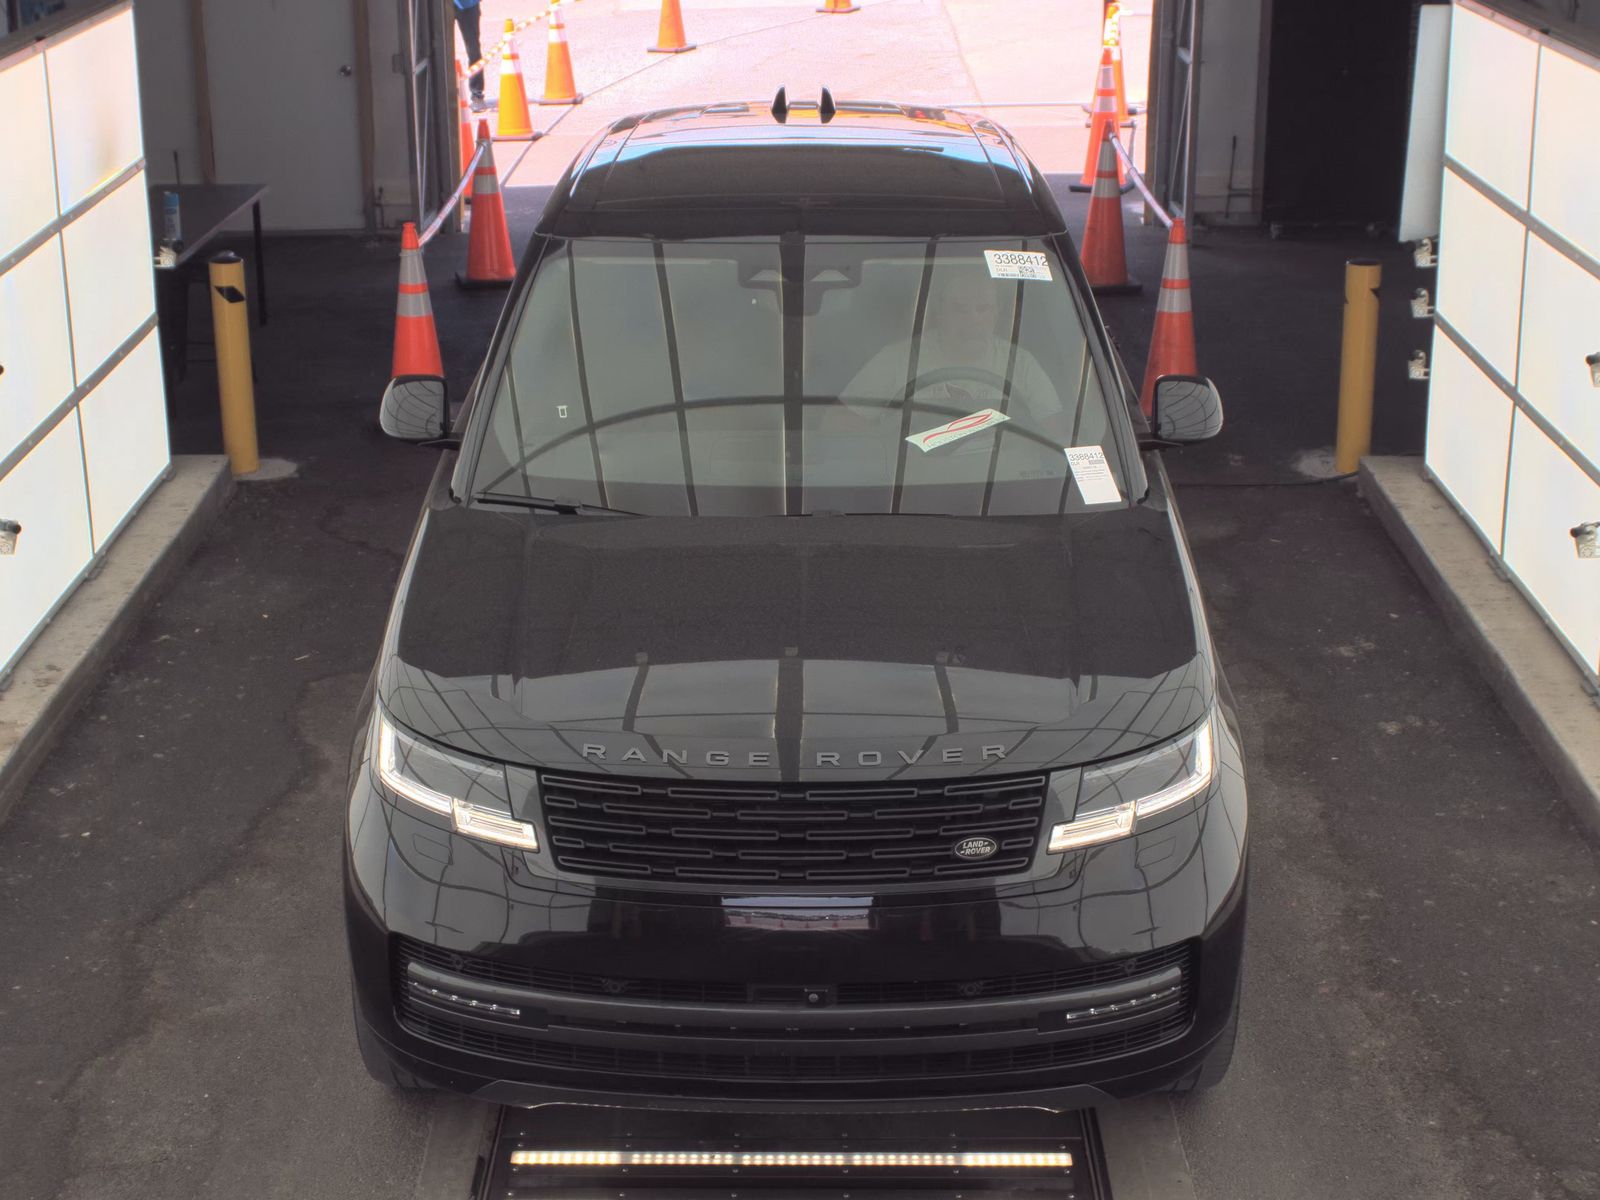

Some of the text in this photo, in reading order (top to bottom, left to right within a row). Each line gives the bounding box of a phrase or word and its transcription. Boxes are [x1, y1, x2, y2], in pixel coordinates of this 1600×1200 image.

[993, 253, 1049, 266] 3388412
[1068, 452, 1105, 462] 3388412
[582, 743, 1007, 766] RANGE ROVER
